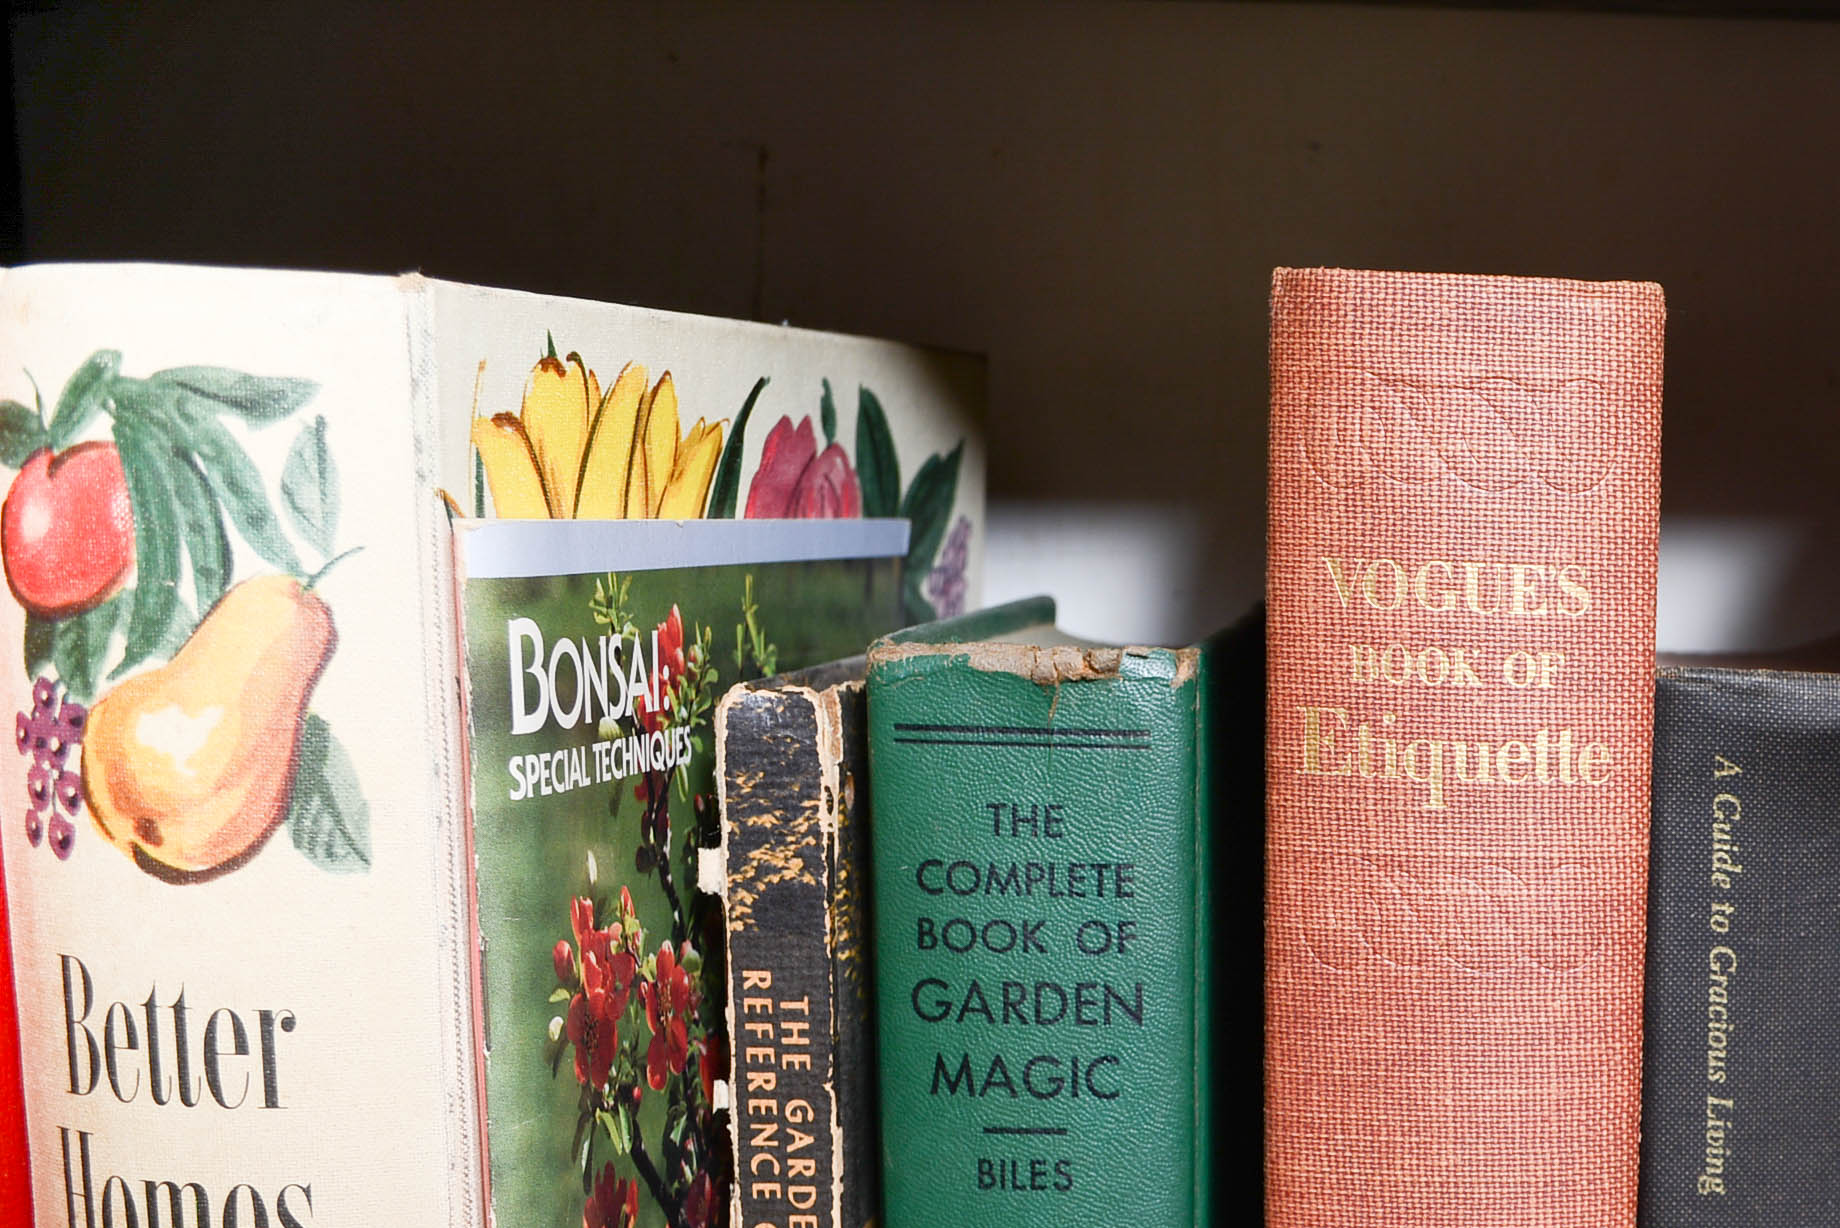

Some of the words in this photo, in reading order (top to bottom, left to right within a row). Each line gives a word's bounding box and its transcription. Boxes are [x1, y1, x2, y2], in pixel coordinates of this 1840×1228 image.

[509, 617, 670, 734] BONSAI:
[1349, 644, 1482, 687] BOOK
[1503, 651, 1564, 688] OF
[509, 747, 591, 800] SPECIAL
[593, 725, 692, 784] TECHNIQUES
[1297, 706, 1610, 808] Etiquette
[1714, 755, 1742, 779] A
[986, 803, 1064, 838] THE
[1711, 793, 1742, 889] Guide
[916, 859, 1135, 898] COMPLETE
[917, 917, 1047, 954] BOOK
[1077, 921, 1137, 955] OF
[1710, 902, 1735, 933] to
[56, 953, 297, 1110] Better
[911, 978, 1144, 1027] GARDEN
[1708, 946, 1736, 1083] Gracious
[780, 996, 811, 1072] THE
[742, 970, 782, 1201] REFERENCE
[930, 1052, 1120, 1100] MAGIC
[977, 1158, 1073, 1191] BILES
[1699, 1096, 1734, 1195] Living
